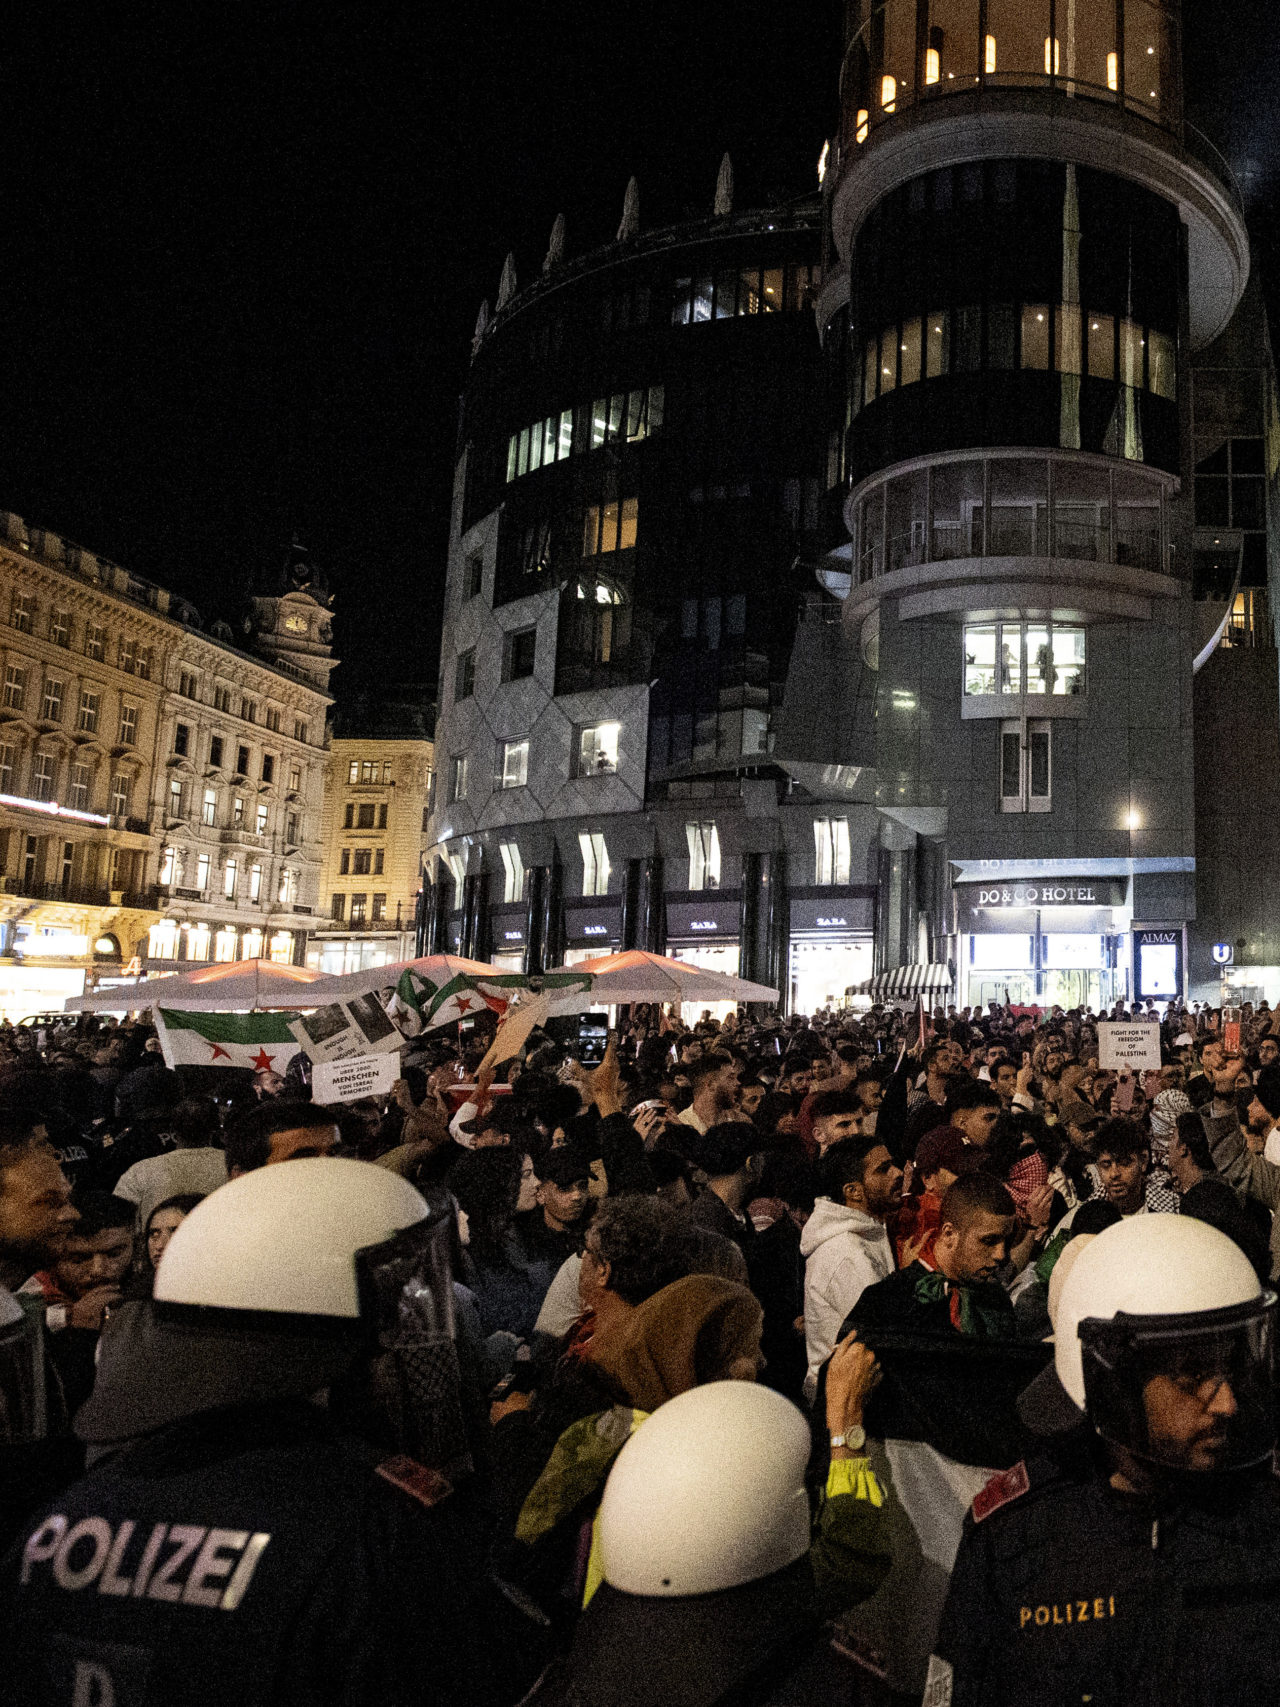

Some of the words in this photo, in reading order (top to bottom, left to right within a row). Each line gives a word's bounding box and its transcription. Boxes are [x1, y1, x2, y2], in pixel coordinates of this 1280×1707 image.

[978, 889, 1000, 904] DO
[1001, 889, 1012, 902] &
[1014, 887, 1038, 902] CO
[1041, 887, 1096, 901] HOTEL
[690, 920, 718, 930] ZARA
[816, 917, 847, 926] ZARA
[1141, 932, 1177, 943] ALMAZ
[1212, 944, 1230, 963] U
[332, 1070, 380, 1084] MENSCHEN
[340, 1085, 373, 1096] ERMORDET
[20, 1513, 272, 1611] POLIZEI
[1020, 1595, 1115, 1628] POLIZEI
